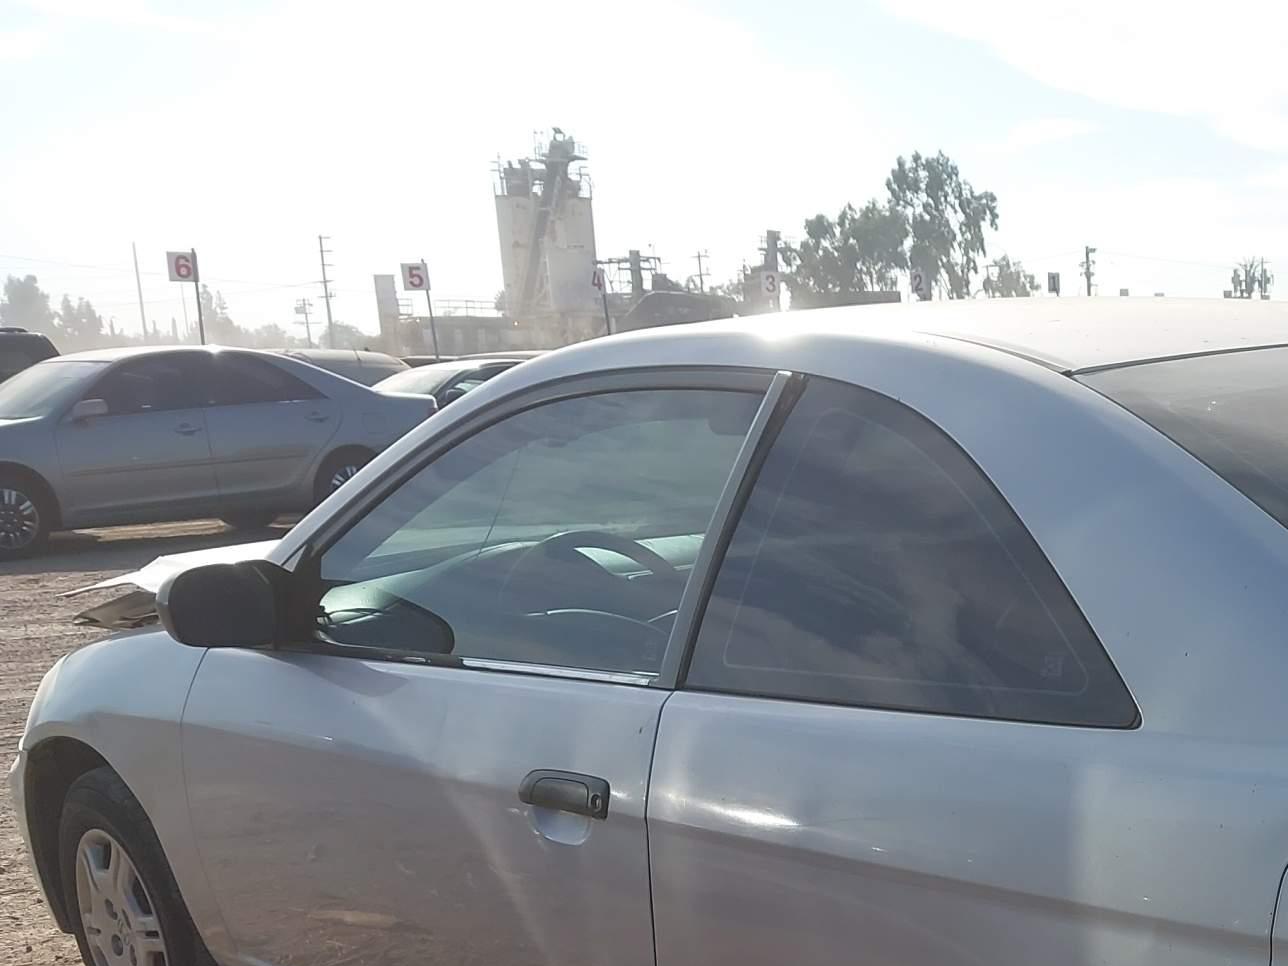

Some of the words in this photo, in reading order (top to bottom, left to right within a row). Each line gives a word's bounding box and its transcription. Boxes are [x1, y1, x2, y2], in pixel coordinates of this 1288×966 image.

[175, 255, 192, 278] 6
[408, 266, 424, 288] 5
[592, 270, 603, 290] 4
[766, 274, 776, 293] 3
[914, 274, 924, 291] 2
